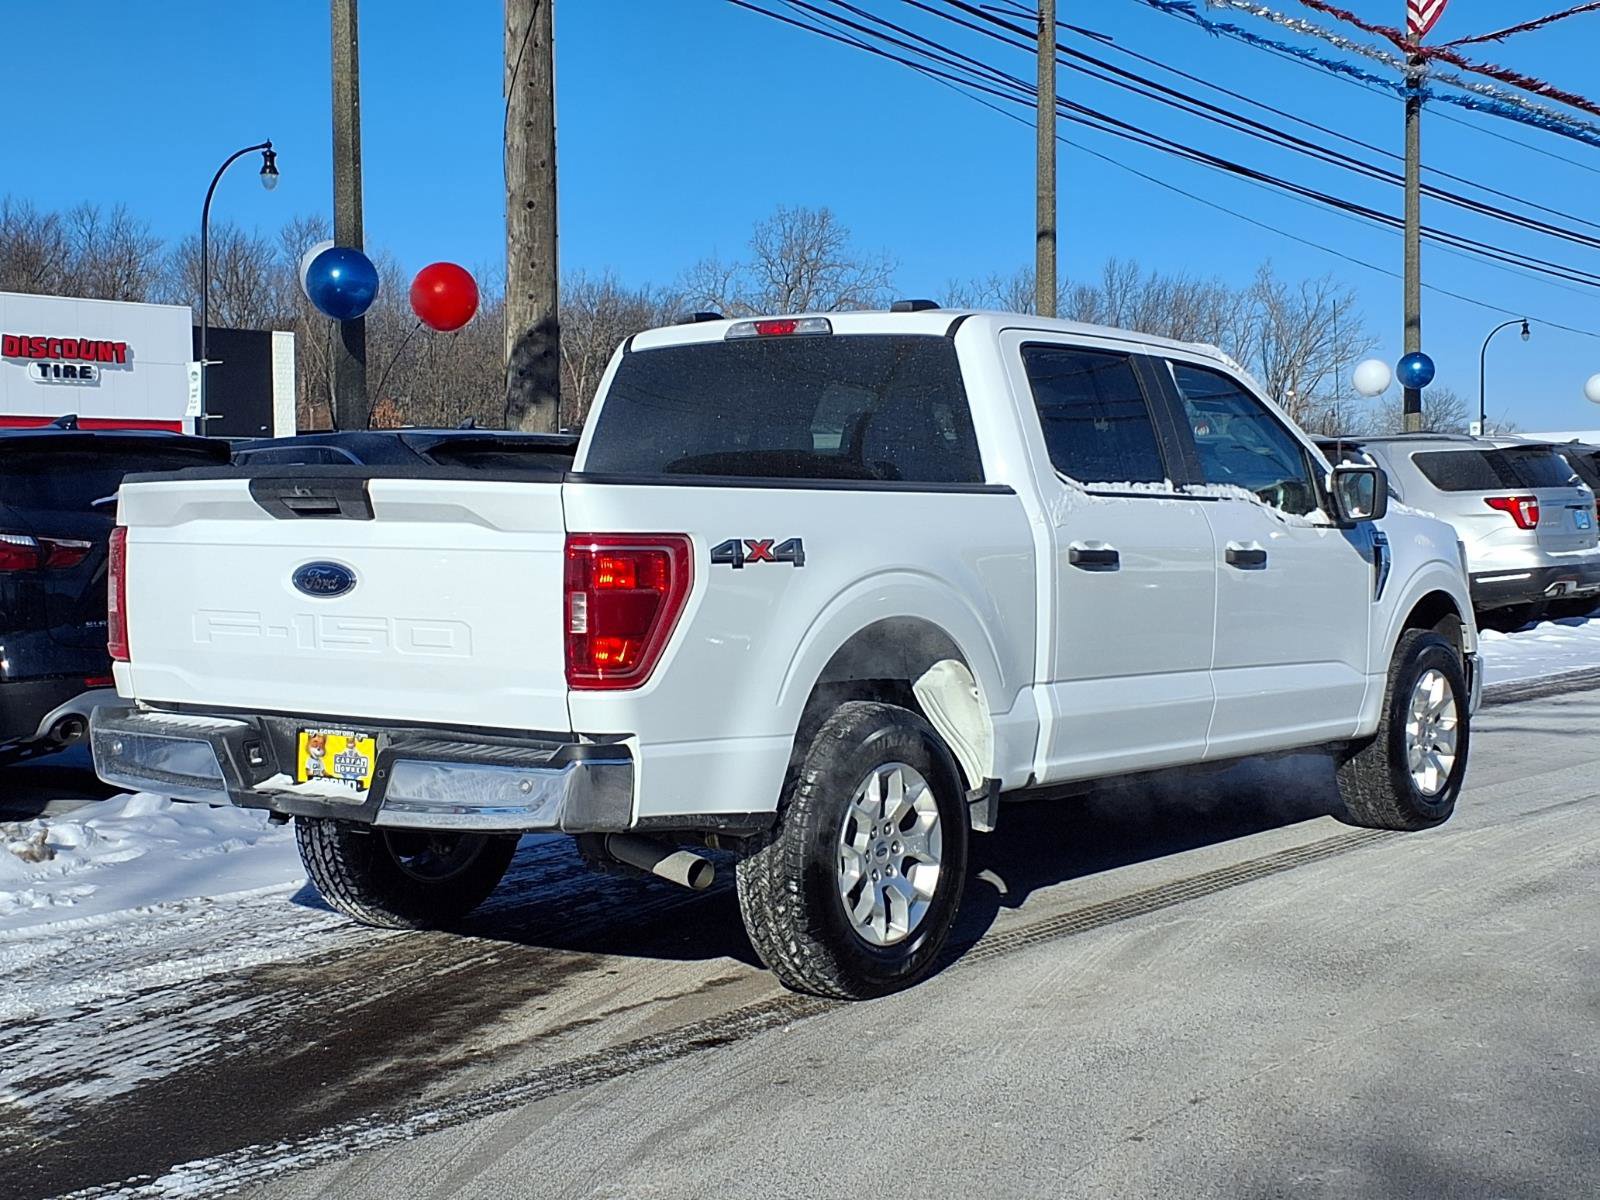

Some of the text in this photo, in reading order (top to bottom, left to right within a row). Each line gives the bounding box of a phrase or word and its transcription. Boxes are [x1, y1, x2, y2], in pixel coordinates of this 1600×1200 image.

[2, 334, 127, 363] DISCOUNT
[37, 363, 93, 379] TIRE
[192, 608, 472, 657] F-150
